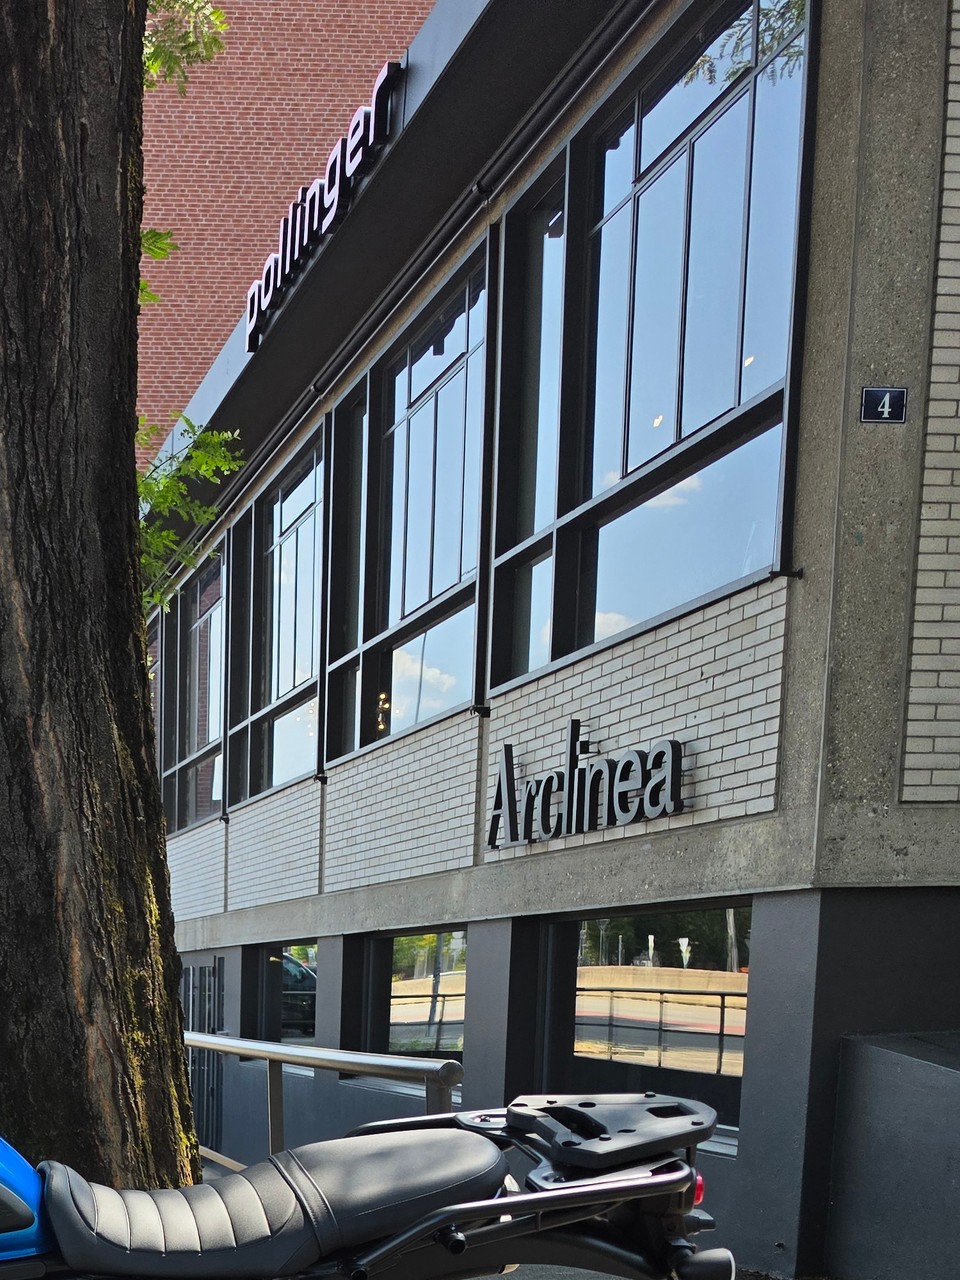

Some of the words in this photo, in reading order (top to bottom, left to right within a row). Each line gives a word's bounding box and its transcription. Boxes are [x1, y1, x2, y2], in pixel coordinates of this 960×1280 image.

[246, 60, 401, 353] pollinger
[877, 392, 892, 418] 4
[485, 718, 684, 850] Arclinea
